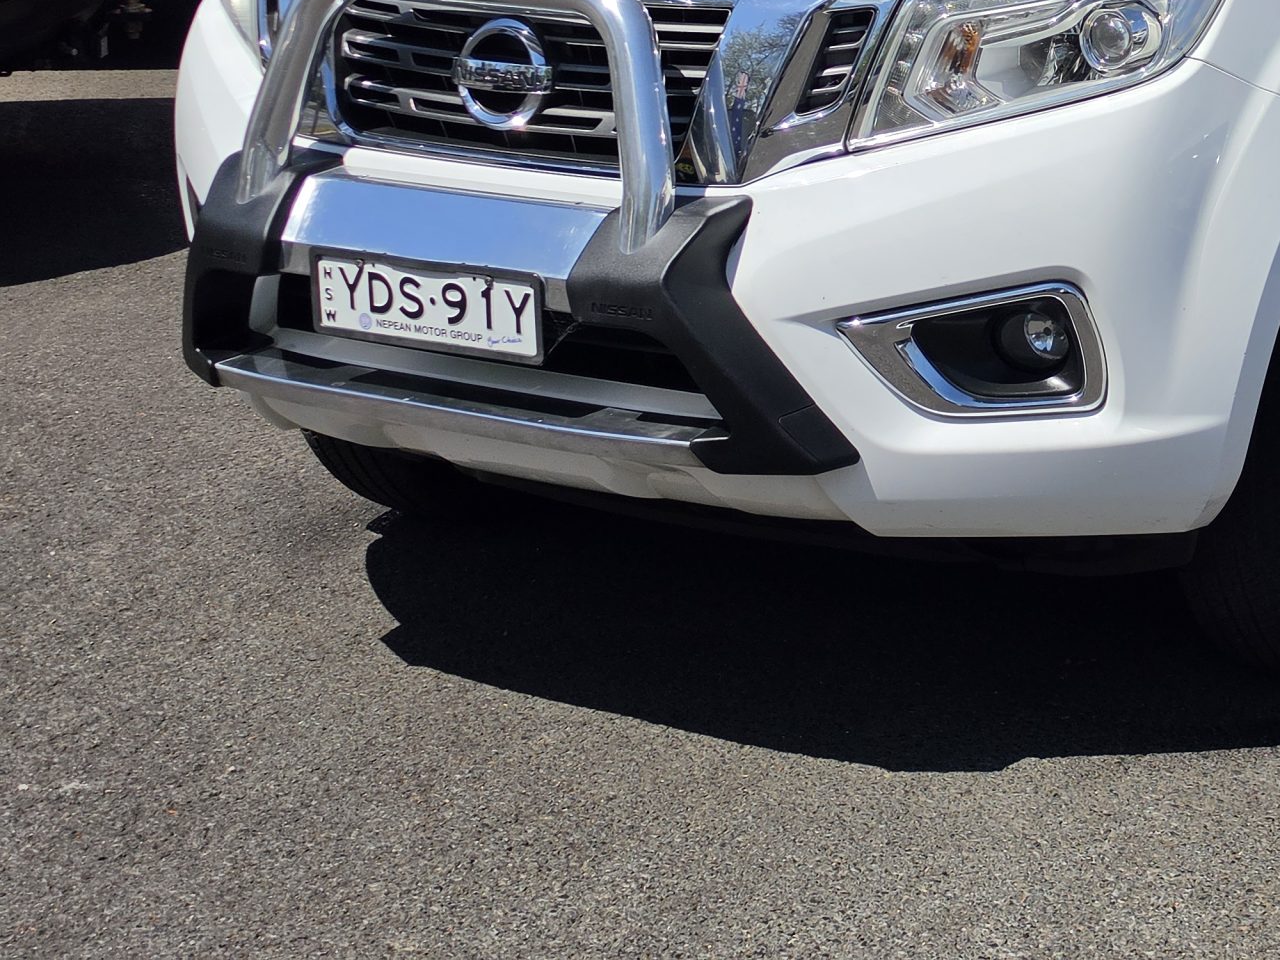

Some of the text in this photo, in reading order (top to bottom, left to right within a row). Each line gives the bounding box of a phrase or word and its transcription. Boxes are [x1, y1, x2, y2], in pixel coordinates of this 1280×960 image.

[375, 318, 483, 343] NEPEAN MOTOR GROUP
